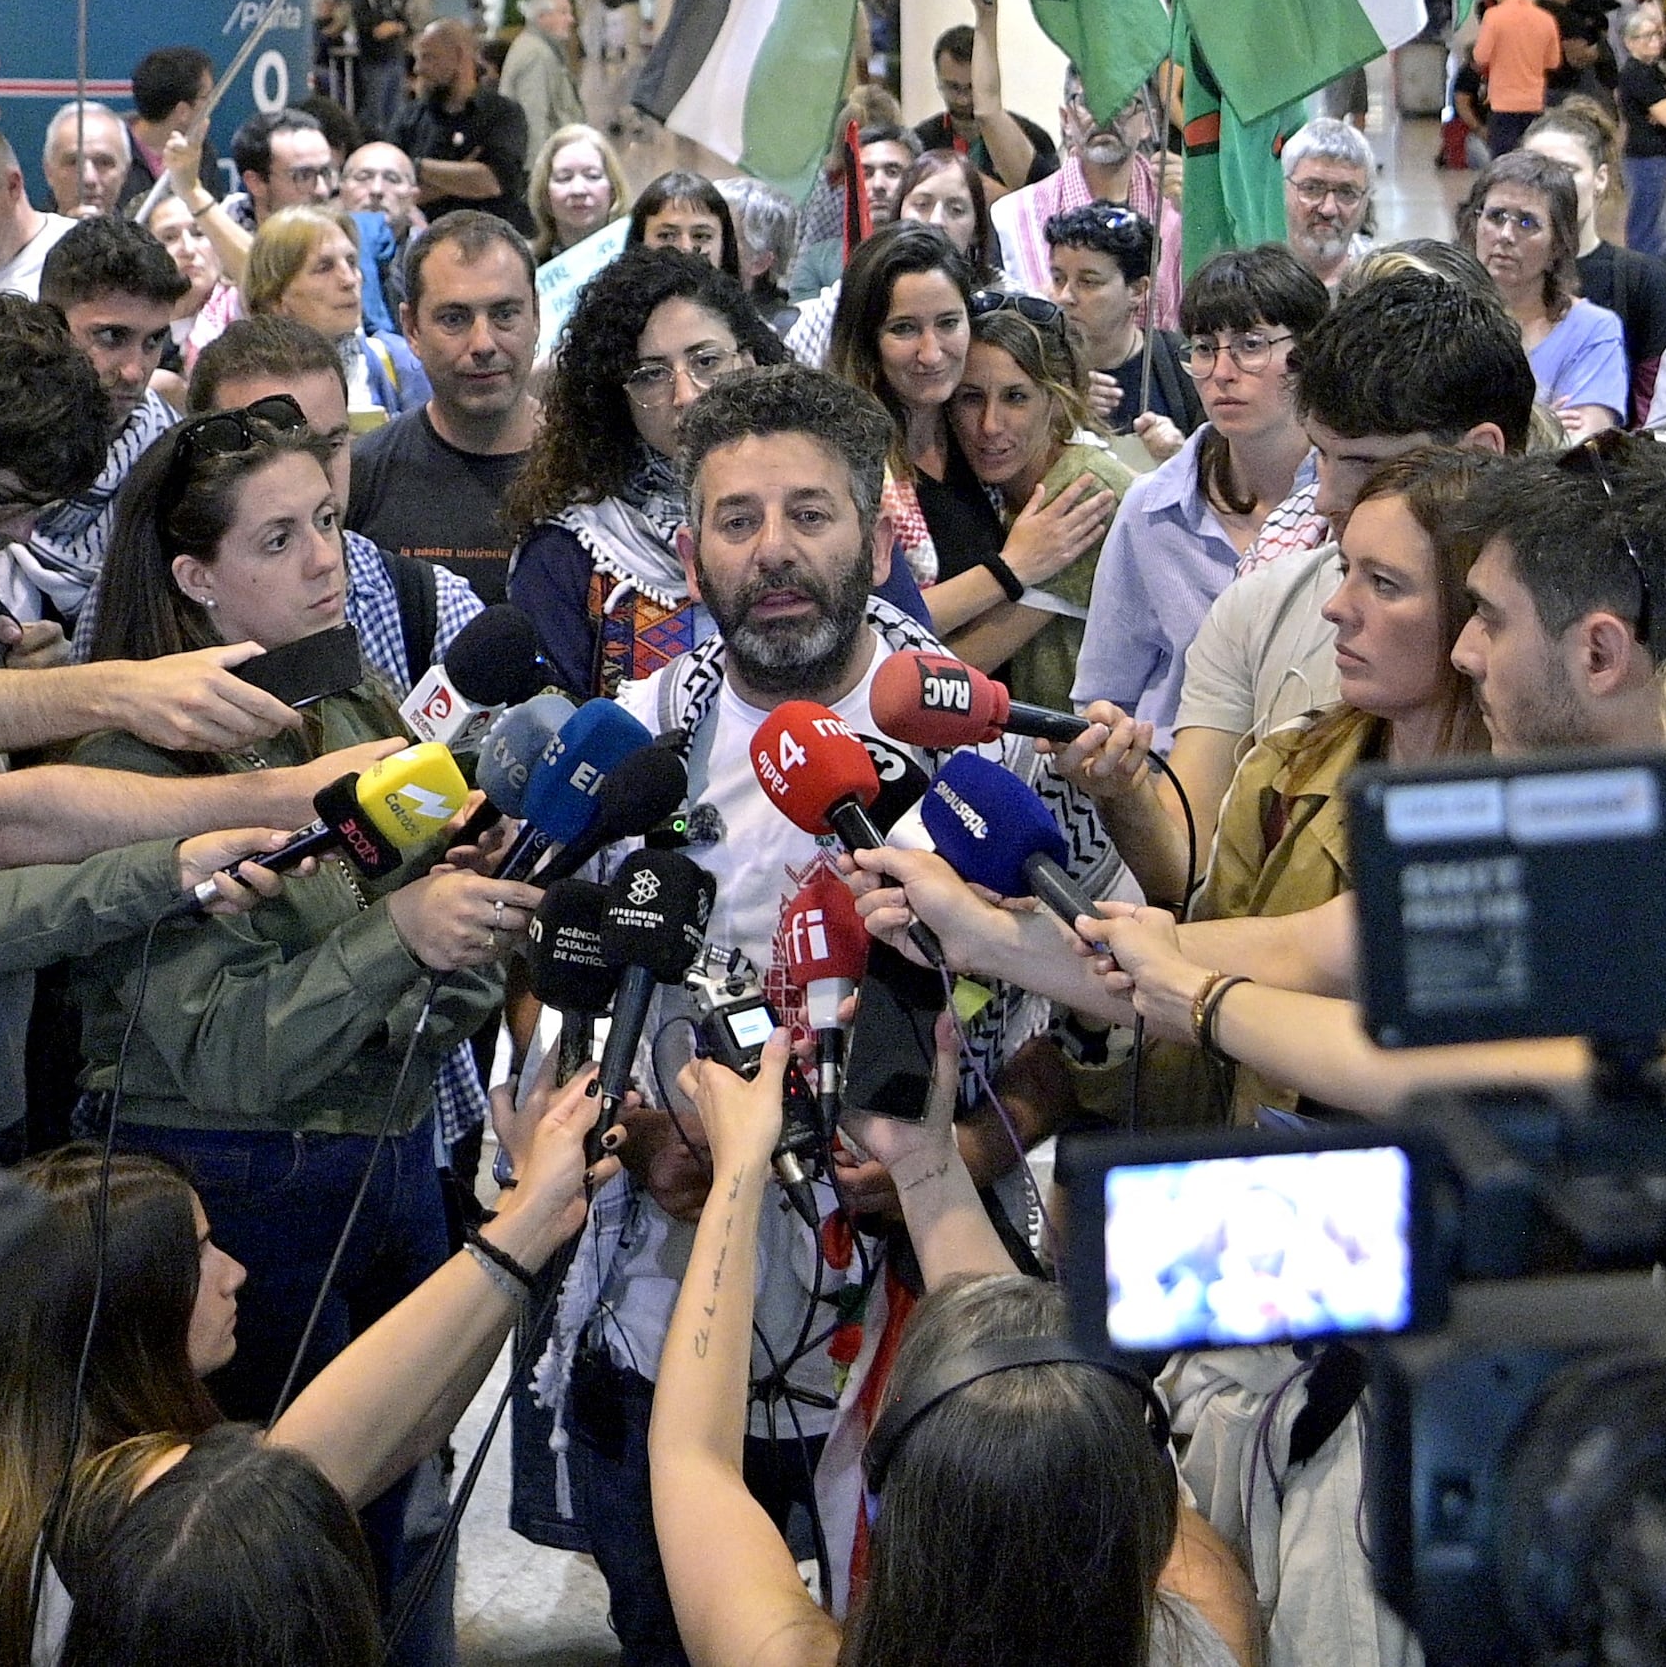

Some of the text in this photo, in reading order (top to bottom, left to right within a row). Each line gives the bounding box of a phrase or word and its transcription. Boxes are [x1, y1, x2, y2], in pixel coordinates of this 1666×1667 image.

[924, 676, 972, 711] RAC
[779, 729, 807, 772] 4
[811, 718, 862, 744] rne
[493, 737, 529, 790] tve
[784, 908, 830, 967] rfi
[552, 949, 608, 968] DE NOTÍCI
